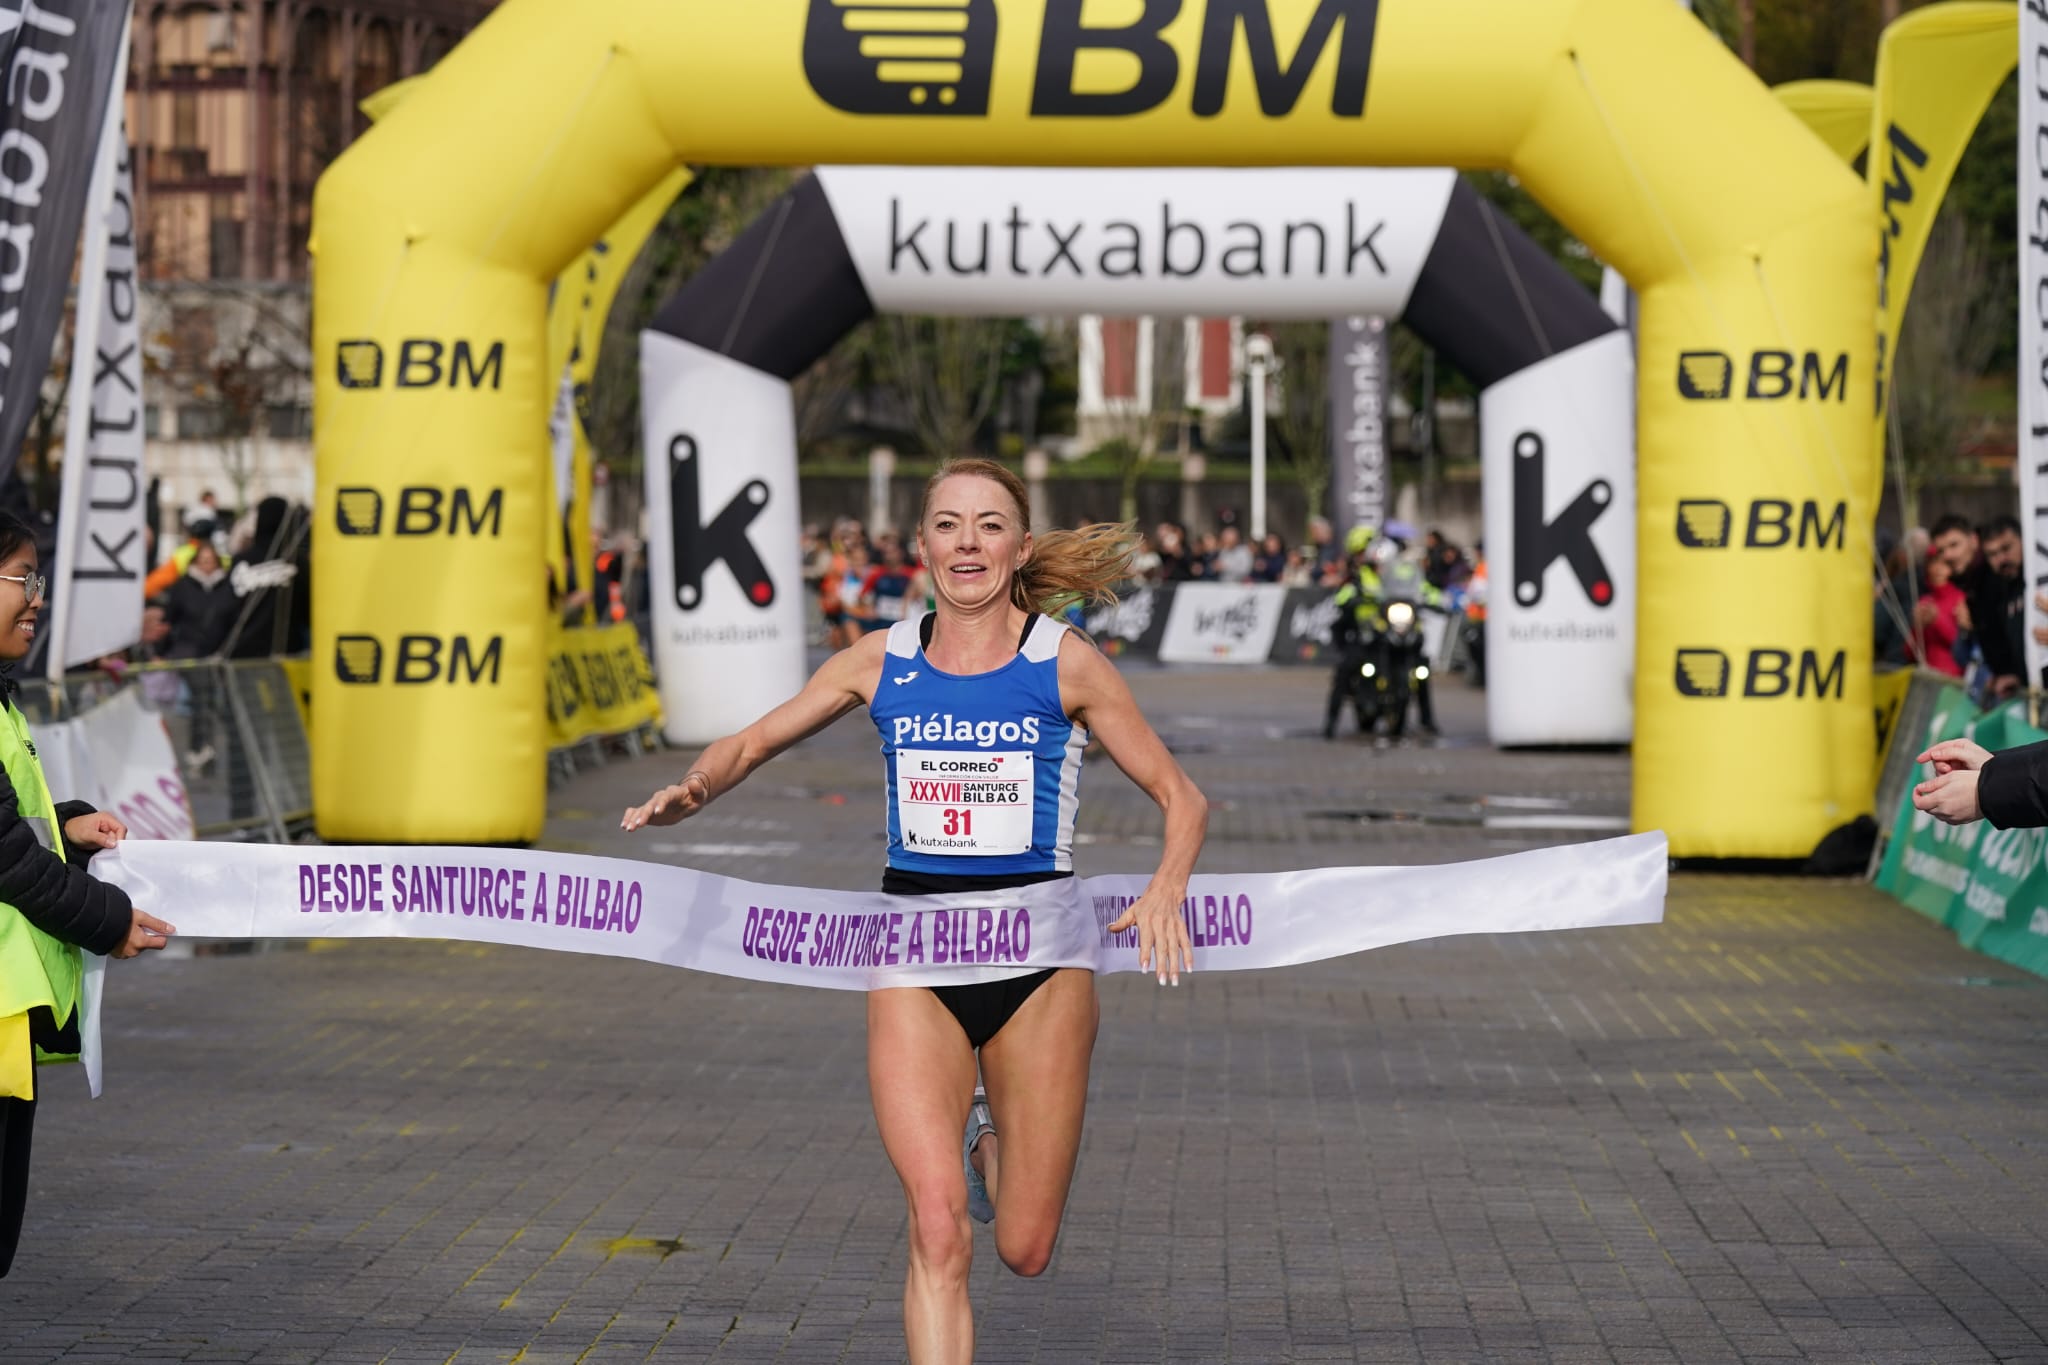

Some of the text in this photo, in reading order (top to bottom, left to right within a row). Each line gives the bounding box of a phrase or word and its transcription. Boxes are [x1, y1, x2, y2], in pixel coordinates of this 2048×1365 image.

[1029, 0, 1378, 119] BM
[889, 199, 1387, 276] kutxabank
[396, 339, 505, 390] BM
[1745, 351, 1850, 402] BM
[395, 486, 504, 537] BM
[1744, 499, 1848, 551] BM
[394, 634, 503, 685] BM
[1743, 649, 1847, 700] BM
[910, 781, 961, 803] XXXVII
[921, 761, 999, 773] EL CORREO
[963, 783, 1019, 792] SANTURCE
[943, 809, 972, 836] 31
[963, 792, 1019, 803] BILBAO
[920, 836, 978, 848] kutxabank
[299, 864, 642, 934] DESDE SANTURCE A BILBAO
[1182, 894, 1252, 947] ILBAO
[742, 906, 1031, 967] DESDE SANTURCE A BILBAO
